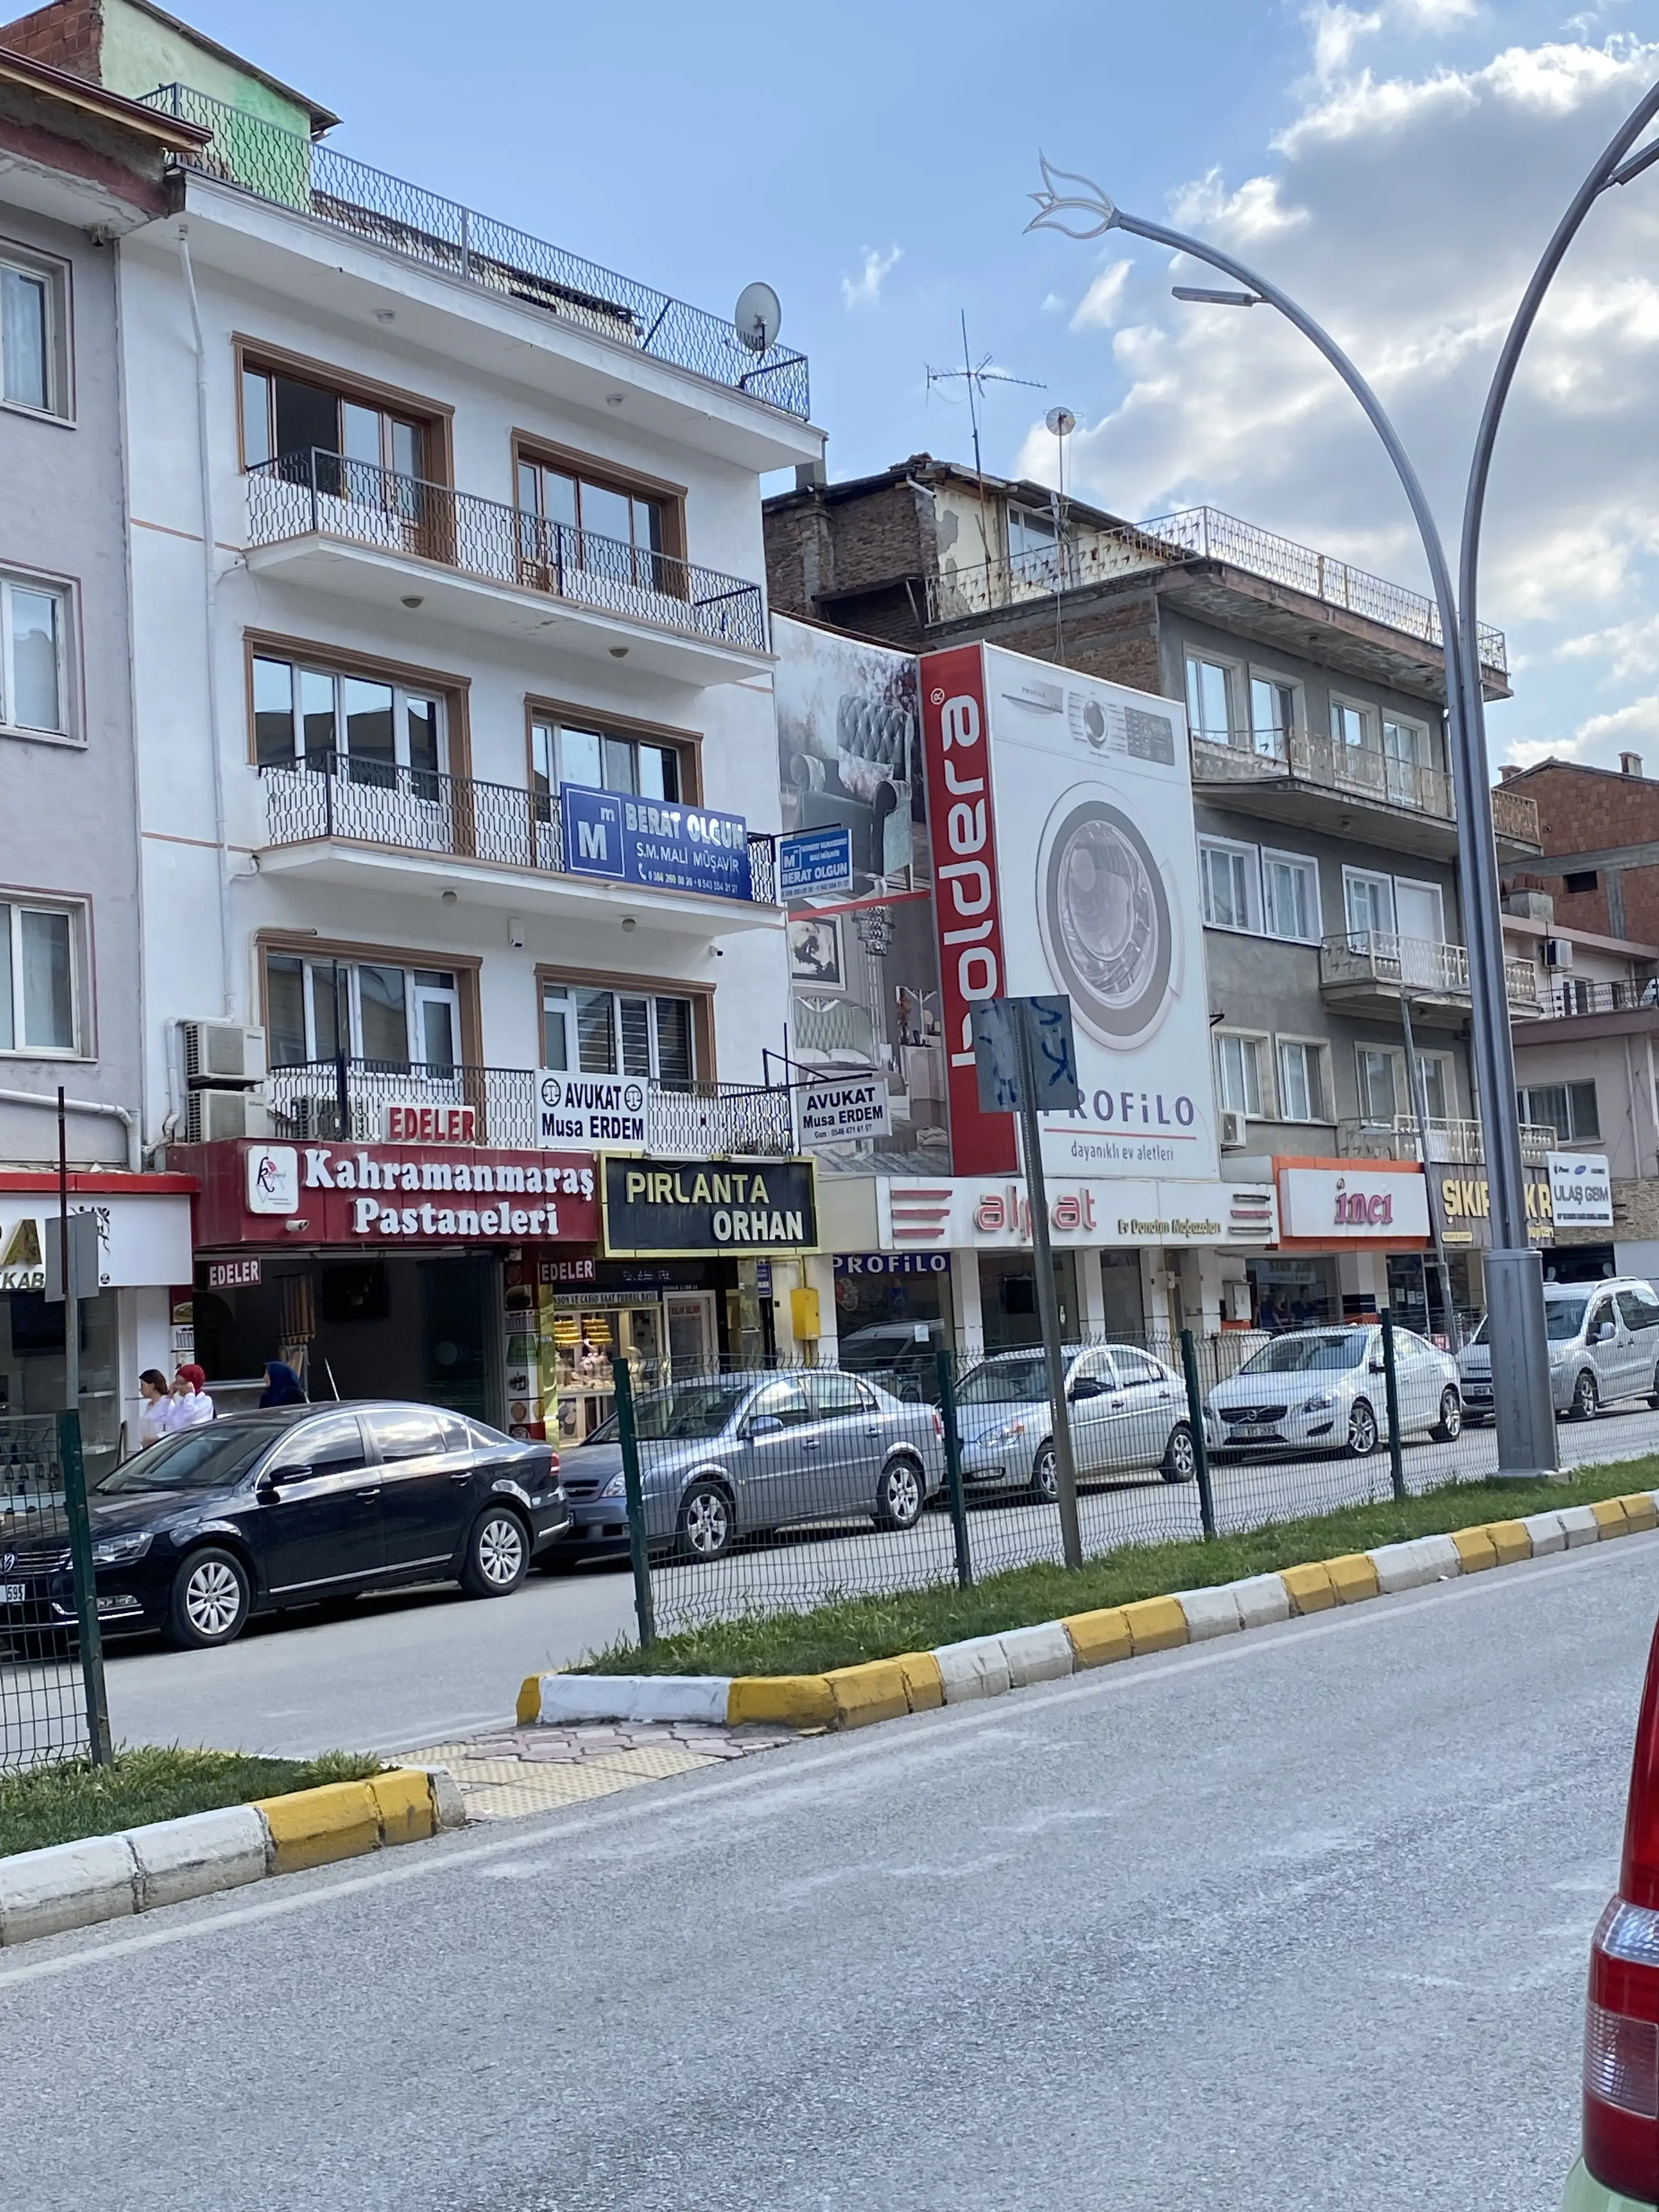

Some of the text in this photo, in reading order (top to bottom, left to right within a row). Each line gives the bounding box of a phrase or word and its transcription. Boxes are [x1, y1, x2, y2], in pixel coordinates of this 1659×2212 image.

[625, 803, 745, 850] BERAT OLGUN
[782, 862, 848, 885] BERAT OLGUN
[565, 1082, 622, 1110] AVUKAT
[806, 1087, 876, 1111] AVUKAT
[390, 1107, 475, 1141] EDELER
[542, 1113, 644, 1140] Musa ERDEM
[803, 1105, 883, 1129] Musa ERDEM
[1071, 1140, 1173, 1161] dayanıklı ev aletleri
[304, 1148, 595, 1201] Kahramanmaraş
[626, 1172, 770, 1204] PIRLANTA
[1585, 1186, 1609, 1202] GSM
[354, 1198, 558, 1235] Pastaneleri
[713, 1210, 803, 1241] ORHAN
[0, 1219, 42, 1265] A
[0, 1272, 44, 1289] KAB
[210, 1261, 259, 1286] EDELER
[541, 1260, 593, 1281] EDELER
